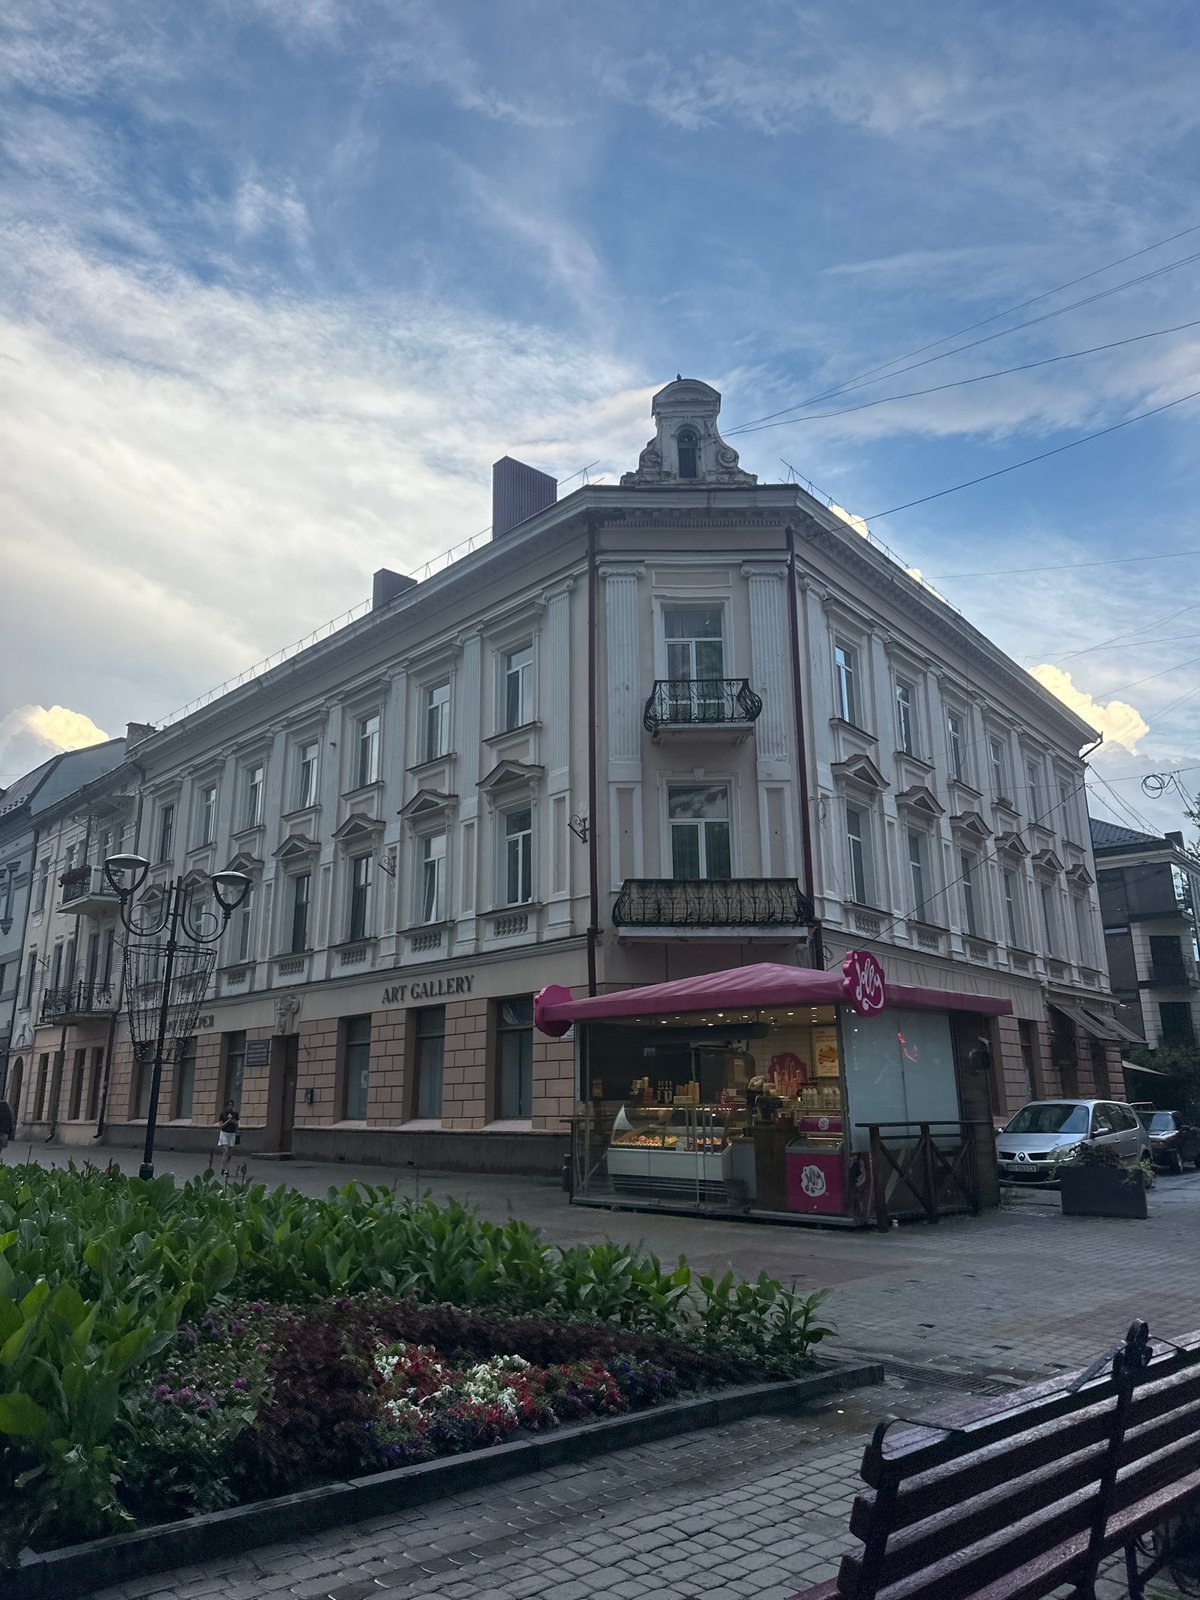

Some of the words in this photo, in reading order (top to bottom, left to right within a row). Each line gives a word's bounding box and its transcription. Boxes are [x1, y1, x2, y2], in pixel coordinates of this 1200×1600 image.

[382, 985, 407, 1004] ART
[410, 974, 474, 999] GALLERY
[854, 953, 884, 1011] jolly
